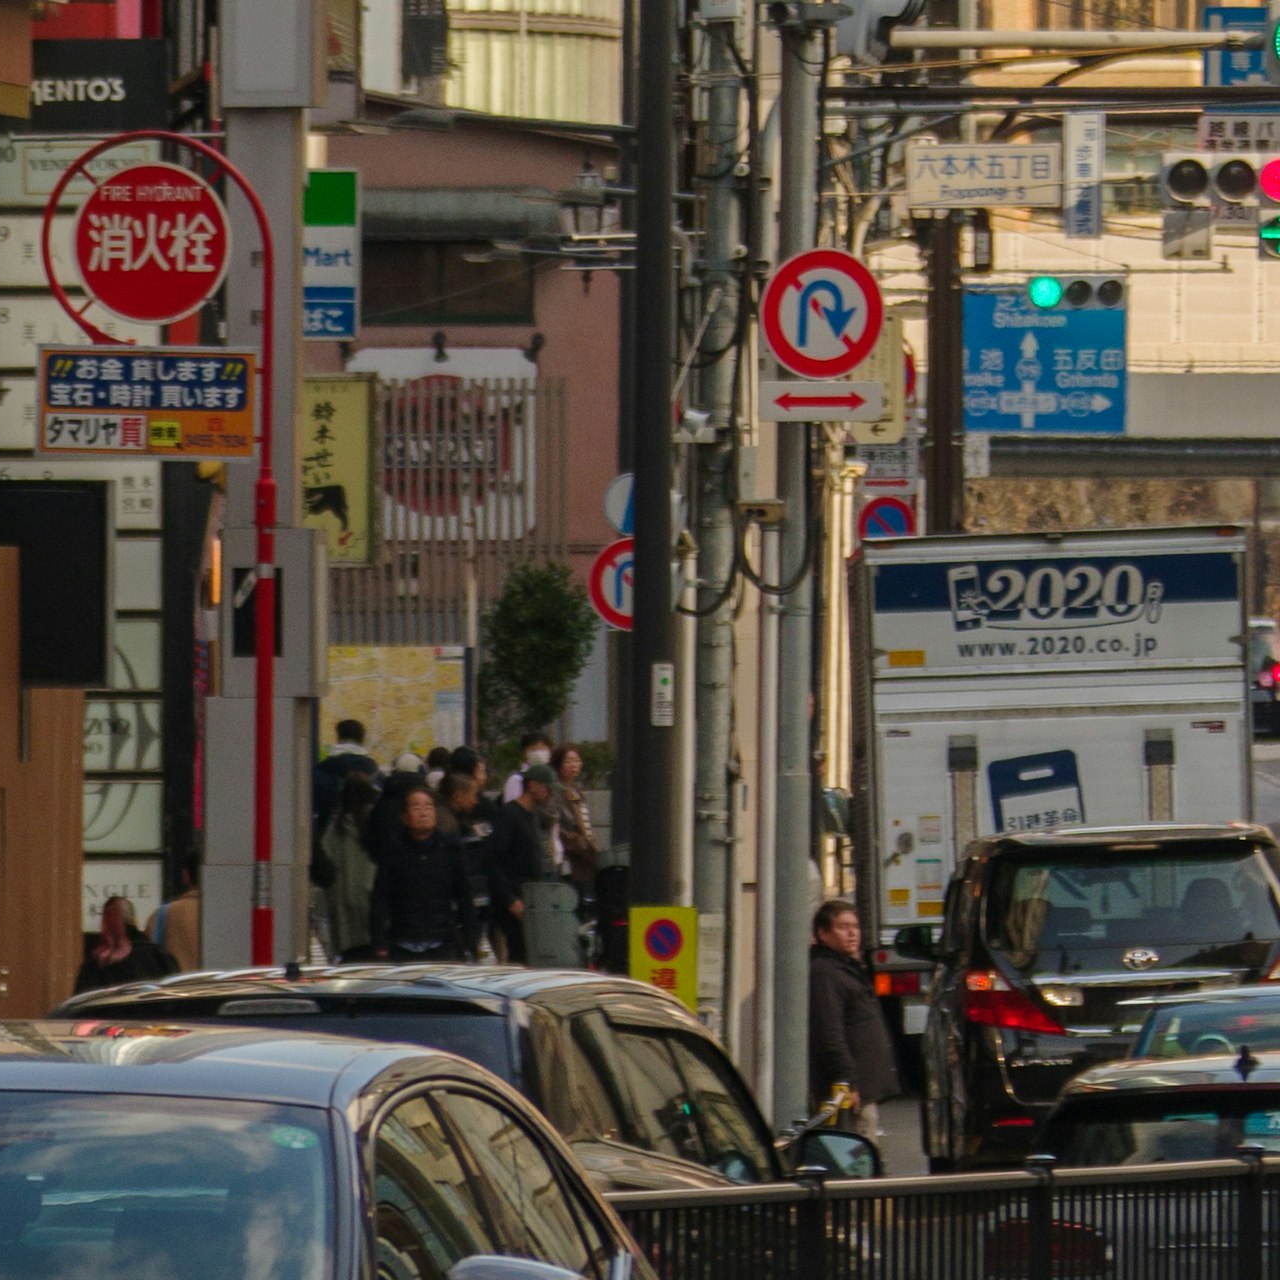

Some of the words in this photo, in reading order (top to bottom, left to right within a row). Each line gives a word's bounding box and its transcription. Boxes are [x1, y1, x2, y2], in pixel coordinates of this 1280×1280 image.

[916, 154, 1050, 180] 六本木五丁目
[100, 186, 132, 202] FIRE
[136, 186, 202, 202] HYDRANT
[88, 213, 217, 272] 消火栓
[1053, 349, 1125, 371] 五反田
[160, 385, 244, 408] 買います
[986, 564, 1144, 620] 2020
[957, 634, 1158, 658] www.2020.co.jp
